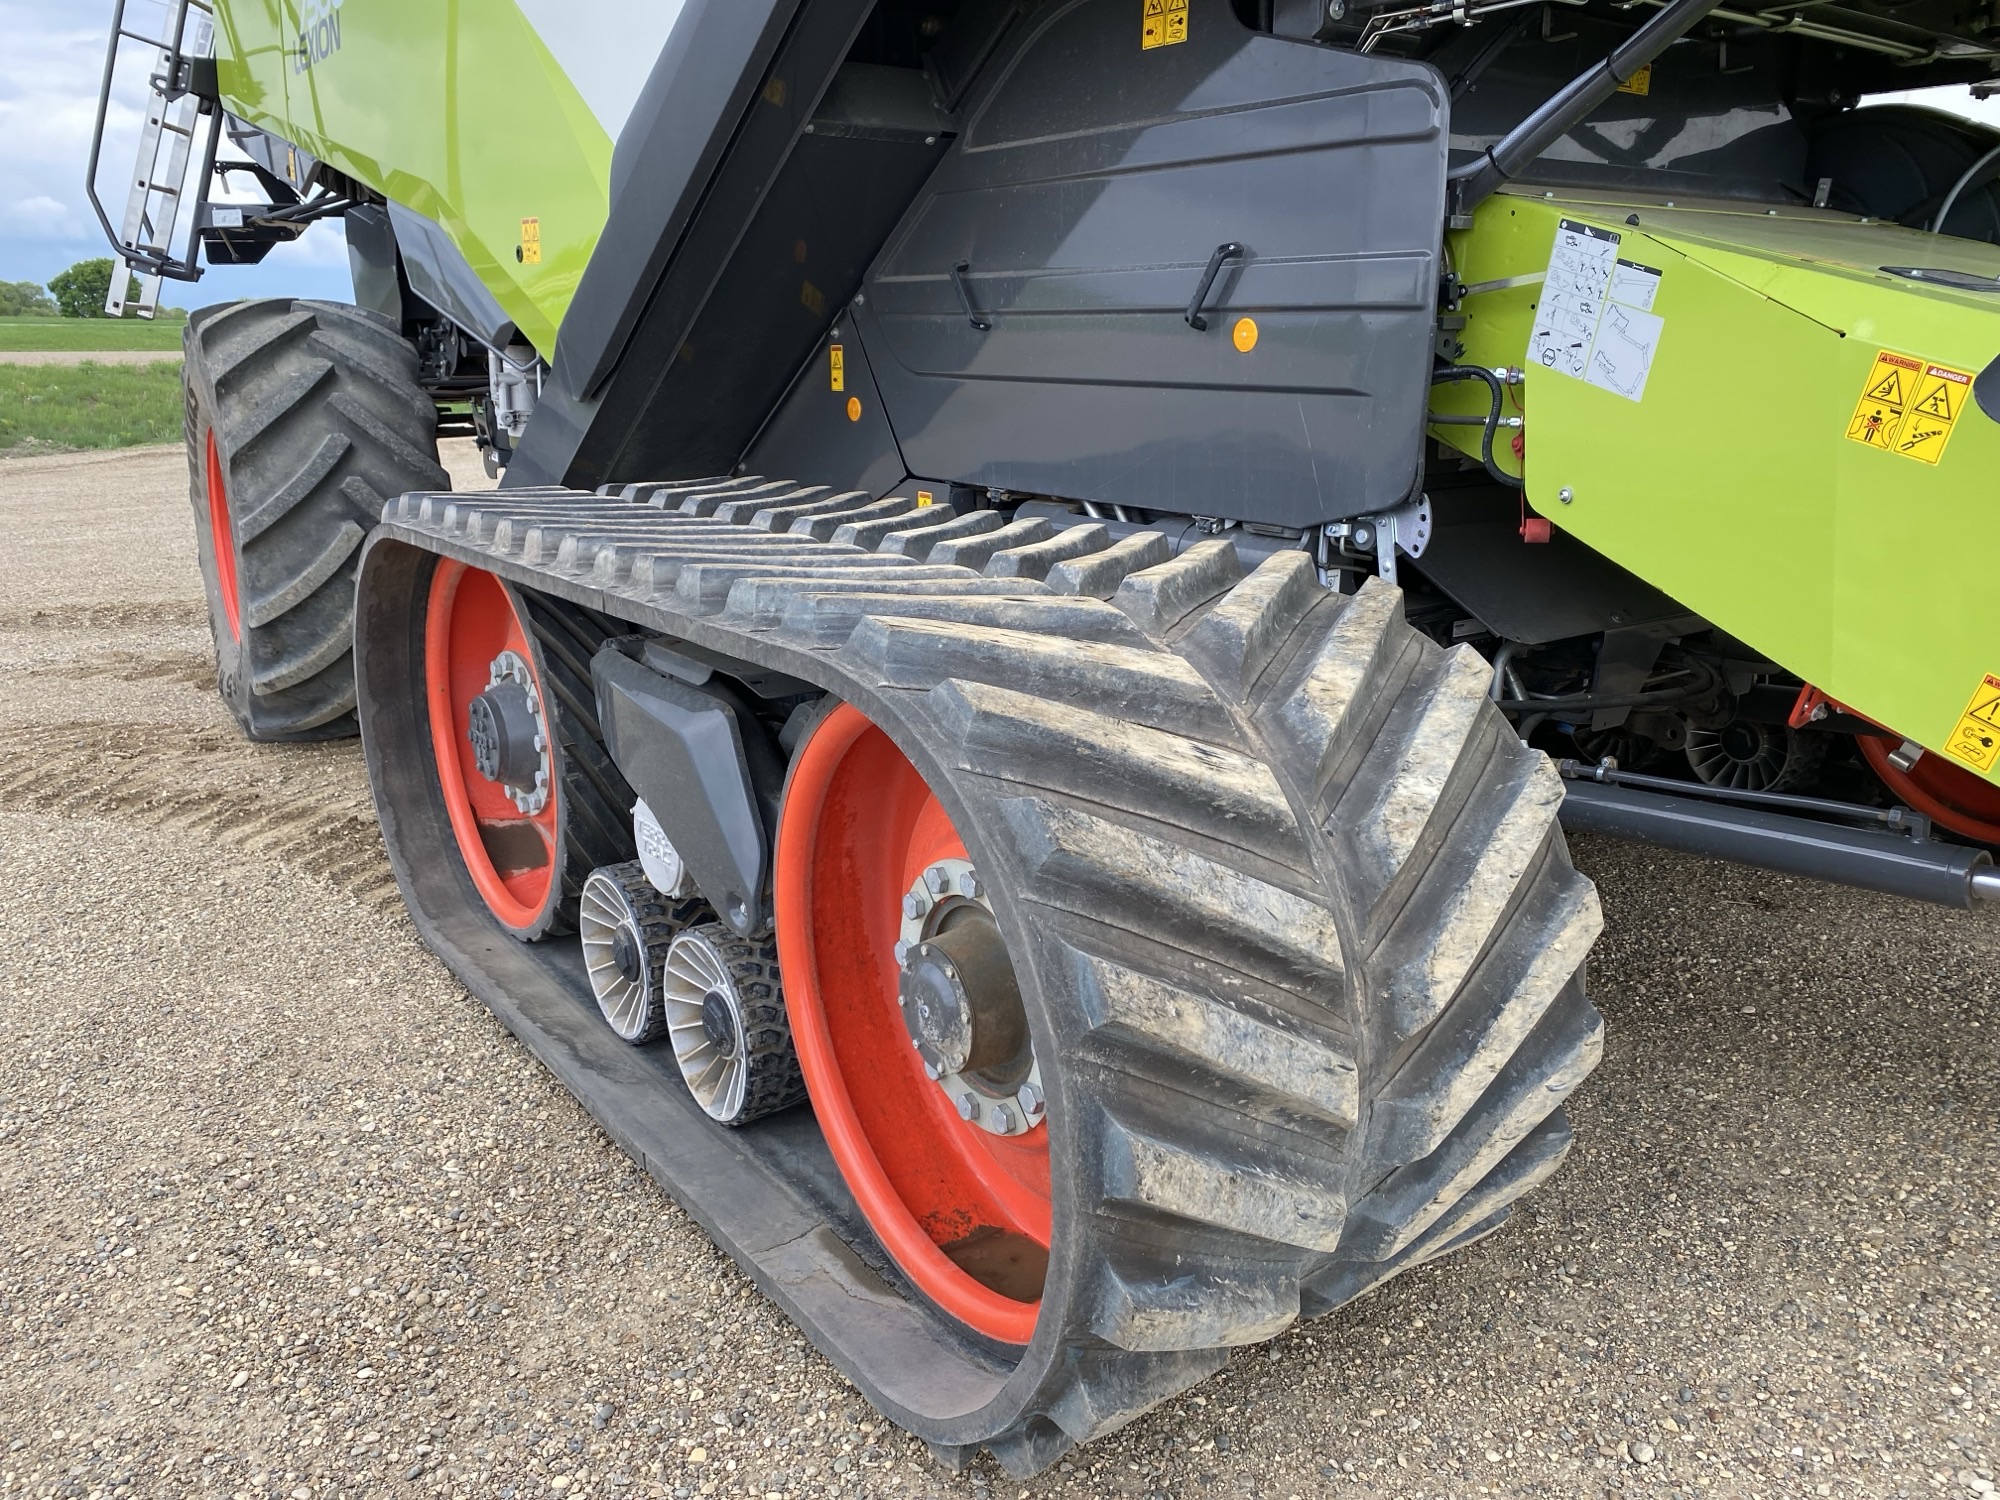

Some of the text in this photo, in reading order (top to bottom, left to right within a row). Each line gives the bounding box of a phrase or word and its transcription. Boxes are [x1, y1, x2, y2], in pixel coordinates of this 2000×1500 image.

[293, 9, 341, 75] LEXION
[1888, 357, 1921, 370] WARNING
[1937, 370, 1968, 383] DANGER
